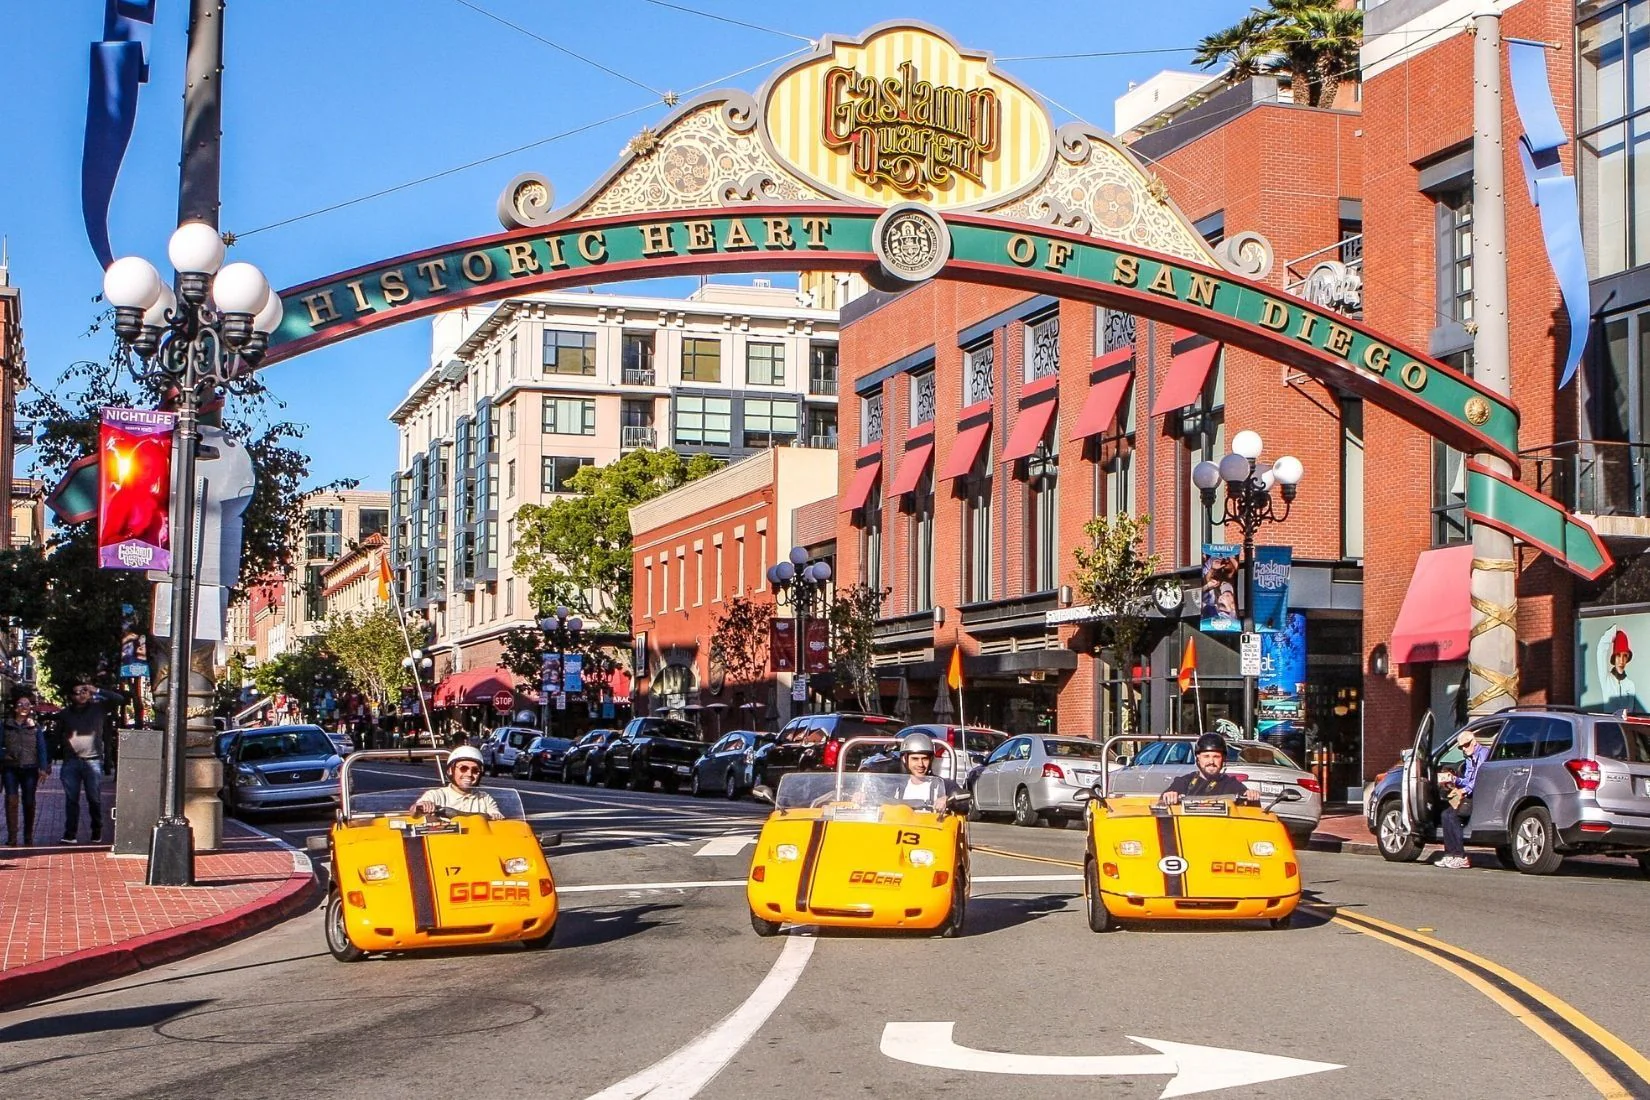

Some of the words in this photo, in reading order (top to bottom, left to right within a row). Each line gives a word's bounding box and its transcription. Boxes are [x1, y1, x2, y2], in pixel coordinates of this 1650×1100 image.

[822, 60, 998, 153] Gaslamp
[851, 125, 983, 193] Quarter
[301, 231, 607, 328] HISTORIC
[640, 216, 831, 256] HEART
[1005, 233, 1074, 271] OF
[1113, 252, 1221, 308] SAN
[1258, 297, 1428, 391] DIEGO
[106, 409, 172, 425] NIGHTLIFE
[1209, 544, 1234, 552] FAMILY
[1253, 559, 1291, 580] Gaslamp
[495, 697, 513, 706] STOP
[896, 829, 921, 846] 13
[445, 866, 462, 876] 17
[1165, 859, 1182, 872] 9
